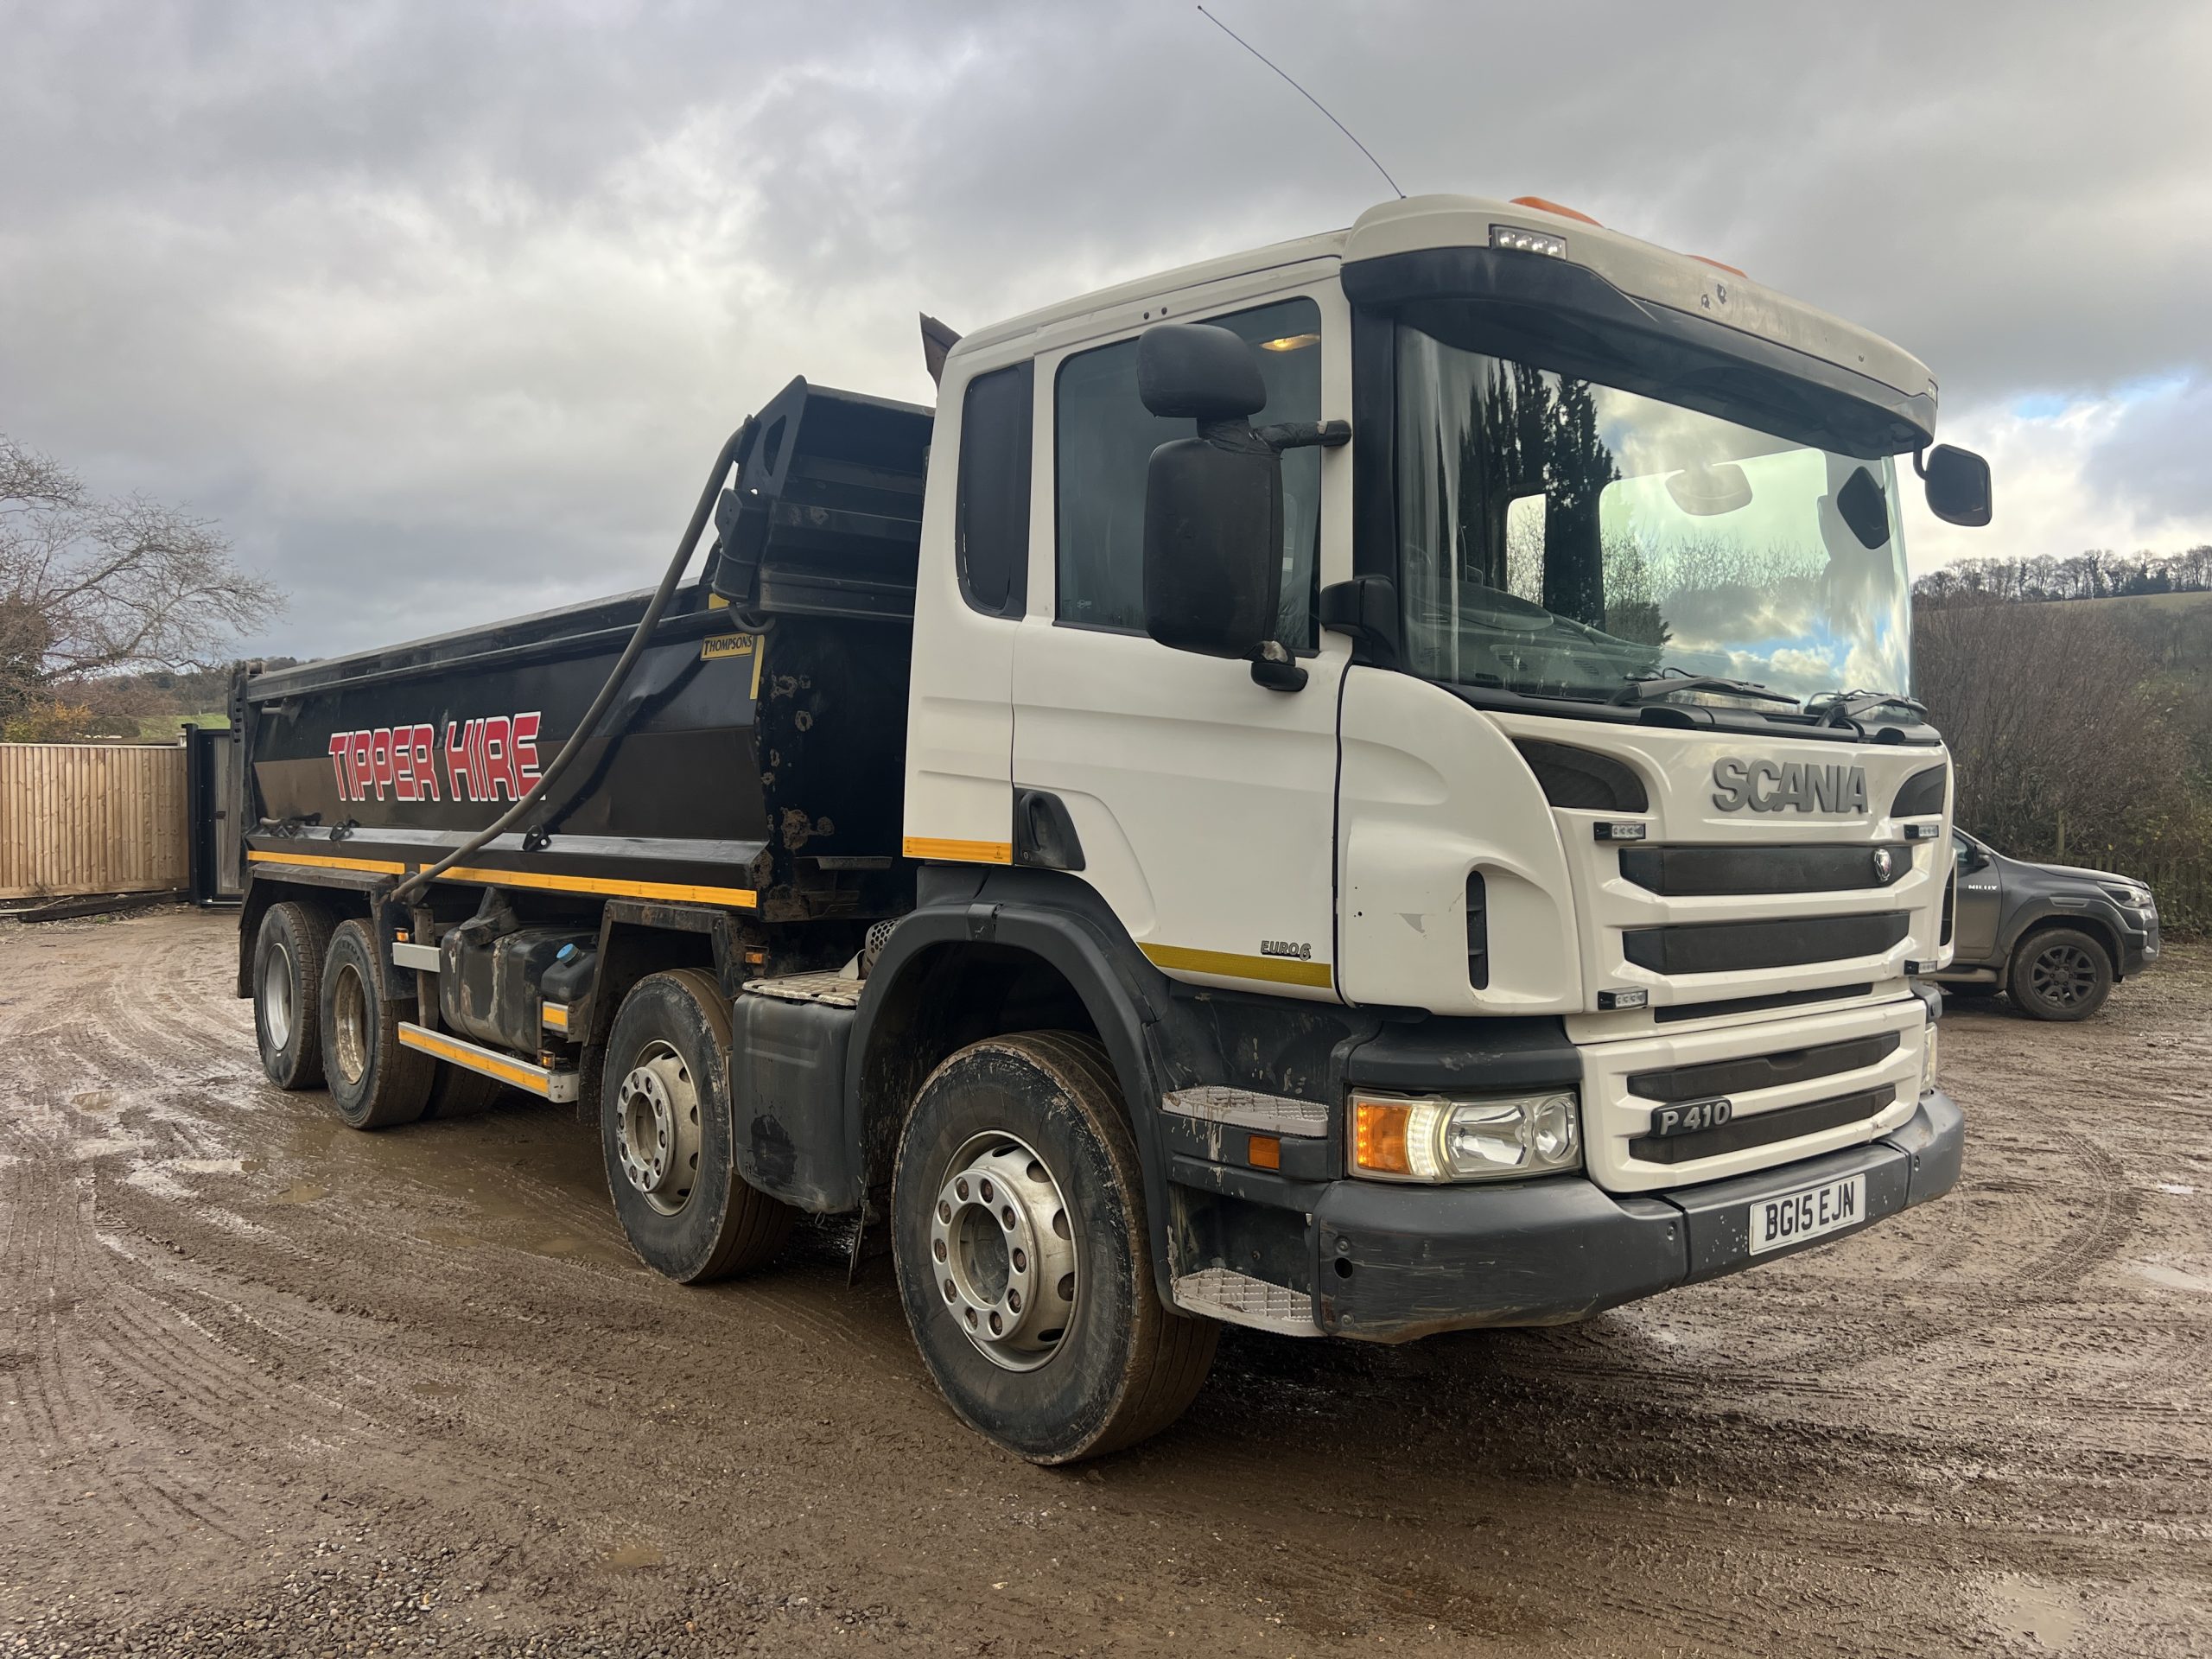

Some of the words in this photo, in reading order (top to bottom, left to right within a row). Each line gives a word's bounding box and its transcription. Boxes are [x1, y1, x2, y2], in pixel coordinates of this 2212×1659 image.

[704, 636, 753, 656] THOMPSONS
[328, 723, 441, 802] TIPPER
[445, 711, 546, 802] HIRE
[1713, 756, 1869, 814] SCANIA
[1660, 1110, 1679, 1135] P
[1682, 1102, 1731, 1130] 410
[1765, 1194, 1814, 1242] BG15
[1819, 1181, 1854, 1226] EJN
